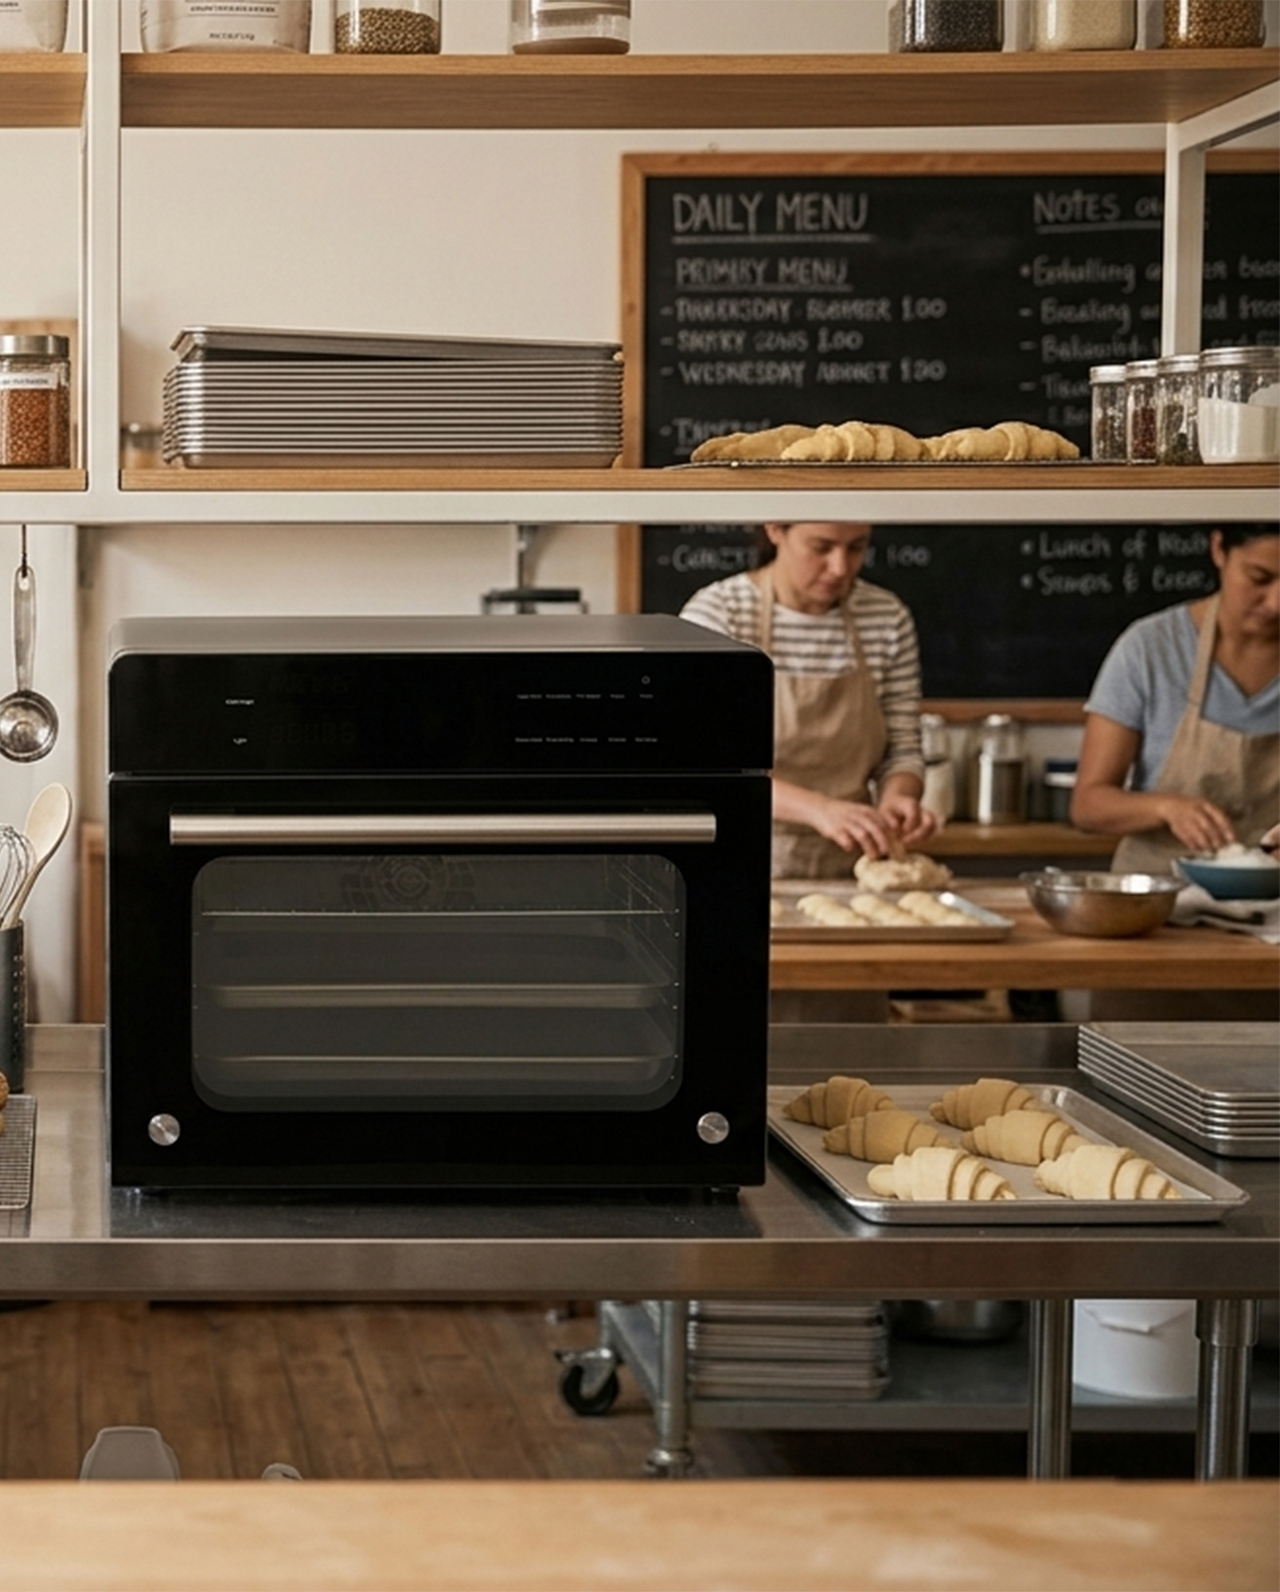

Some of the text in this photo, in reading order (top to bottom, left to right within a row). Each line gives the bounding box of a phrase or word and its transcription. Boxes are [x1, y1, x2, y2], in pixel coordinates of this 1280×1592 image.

[671, 192, 869, 234] DAILY MENU
[1032, 189, 1121, 224] NOTES
[777, 257, 849, 284] MENU
